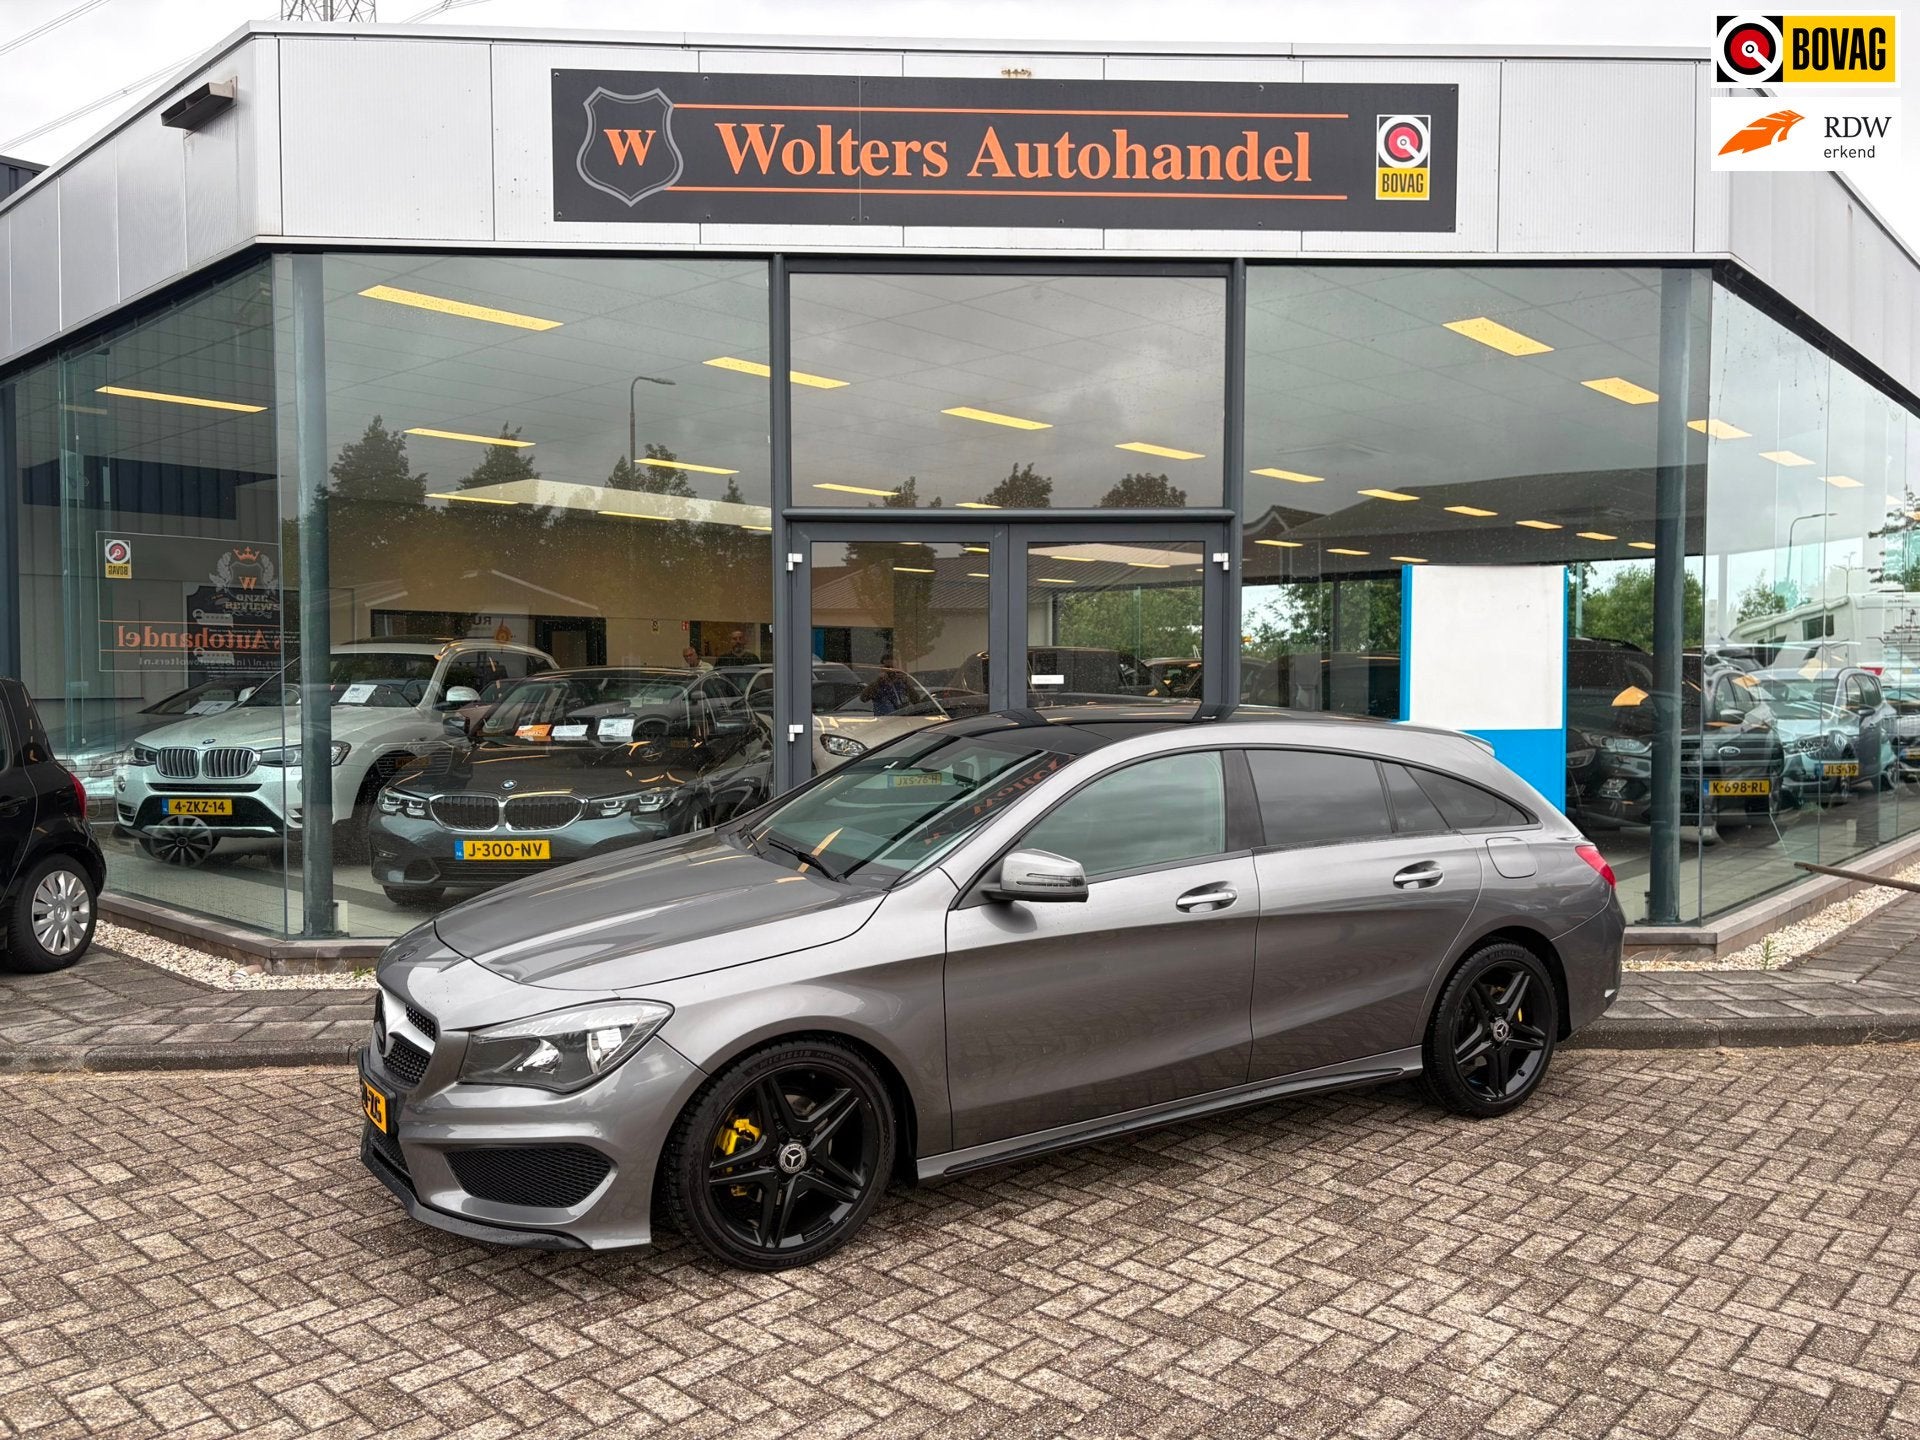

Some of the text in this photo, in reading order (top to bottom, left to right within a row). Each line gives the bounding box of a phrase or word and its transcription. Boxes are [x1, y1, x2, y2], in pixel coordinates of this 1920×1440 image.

[603, 128, 656, 166] W
[714, 122, 1312, 182] Wolters Autohandel
[1381, 173, 1425, 193] BOVAG
[1712, 780, 1766, 794] K-698-RL
[174, 801, 226, 813] 4-ZKZ-14
[468, 843, 543, 857] J-300-NV
